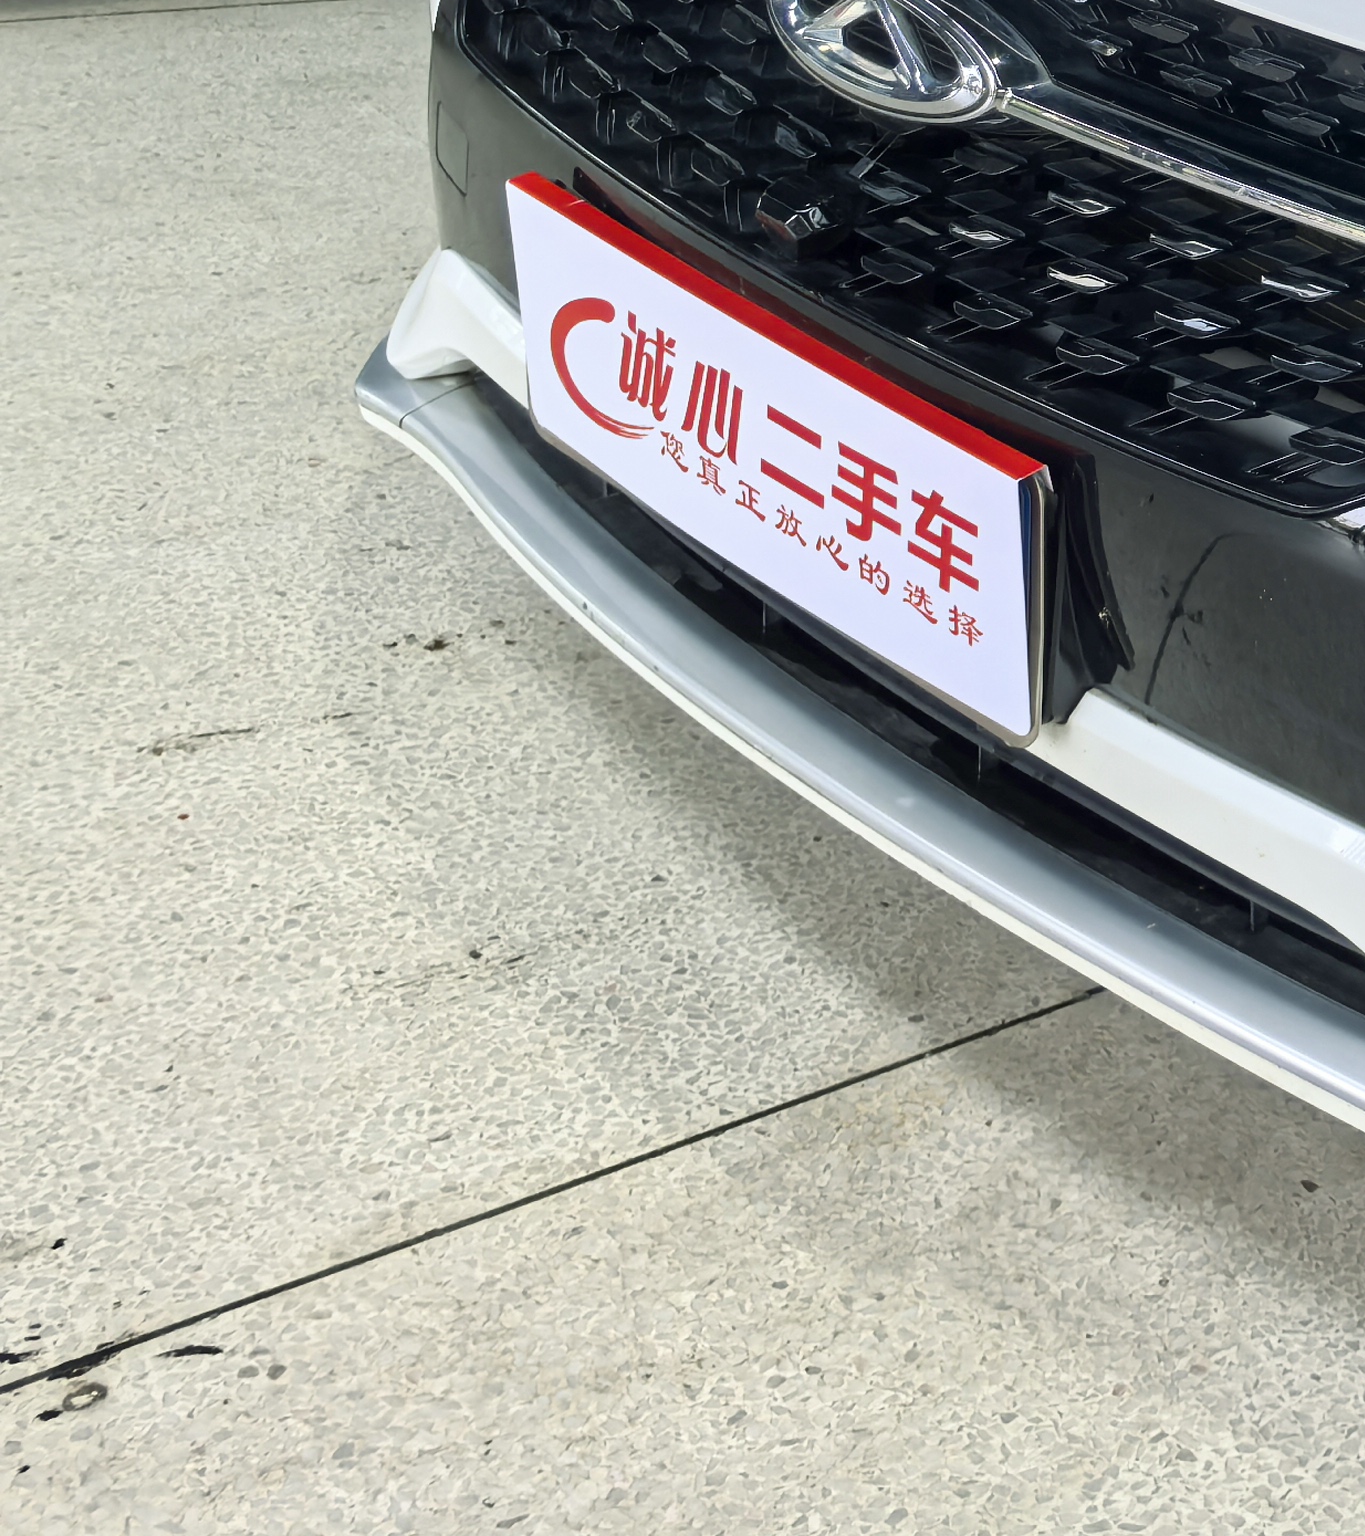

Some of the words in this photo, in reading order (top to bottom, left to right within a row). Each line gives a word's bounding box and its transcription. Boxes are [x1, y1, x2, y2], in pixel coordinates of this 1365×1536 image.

[618, 310, 980, 594] 诚心二手车
[659, 429, 984, 647] 您真正放心的选择
